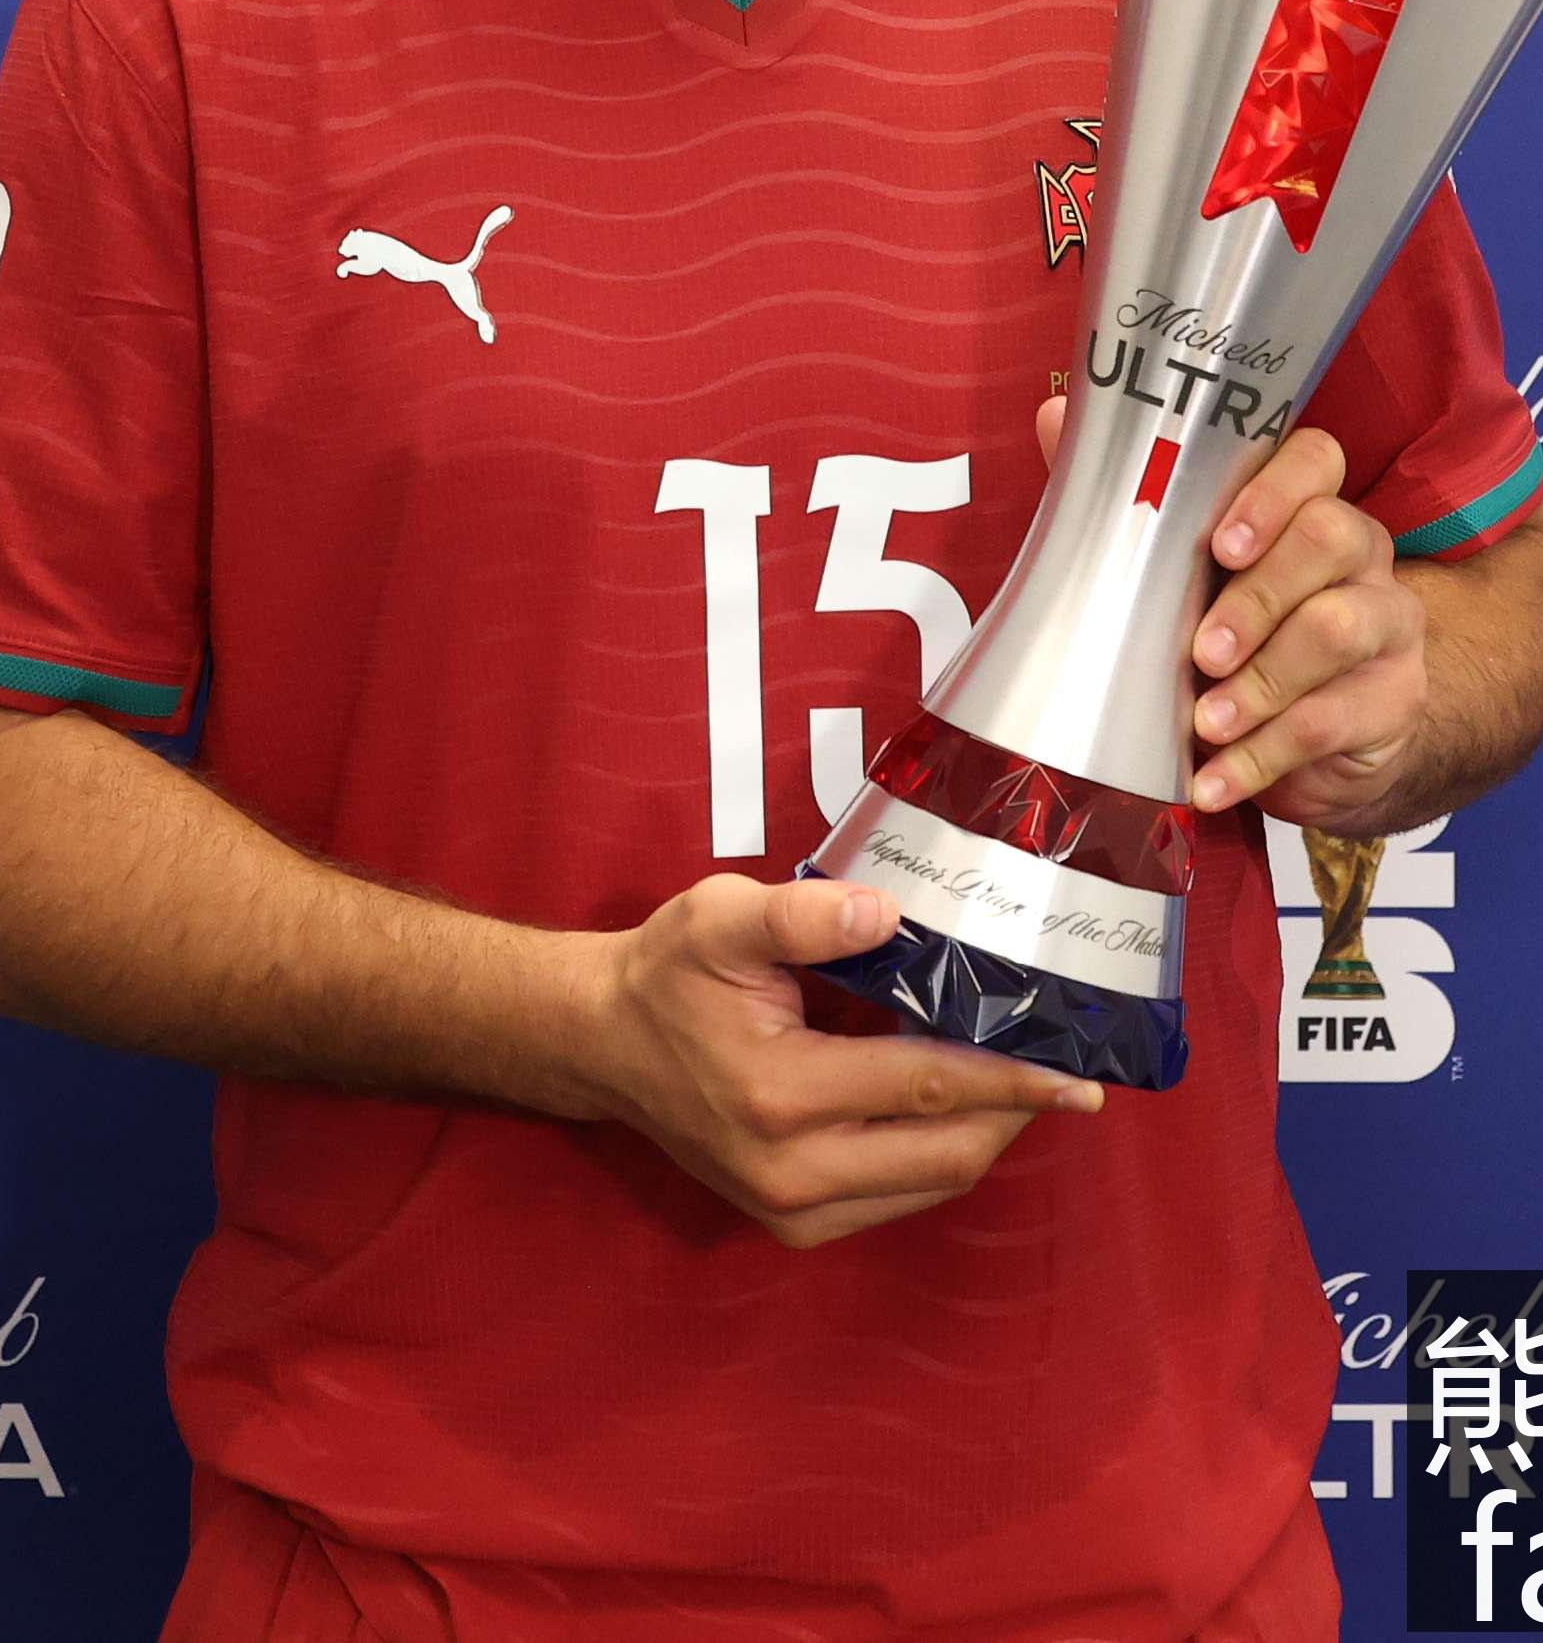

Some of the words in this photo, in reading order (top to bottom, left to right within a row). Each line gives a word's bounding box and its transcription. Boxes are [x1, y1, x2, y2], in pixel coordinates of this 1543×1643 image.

[1087, 330, 1296, 446] ULTRA
[1116, 288, 1295, 375] Michelob
[654, 453, 973, 858] 15
[862, 829, 949, 884] Superior
[1068, 917, 1106, 943] the
[1299, 1016, 1397, 1052] FIFA
